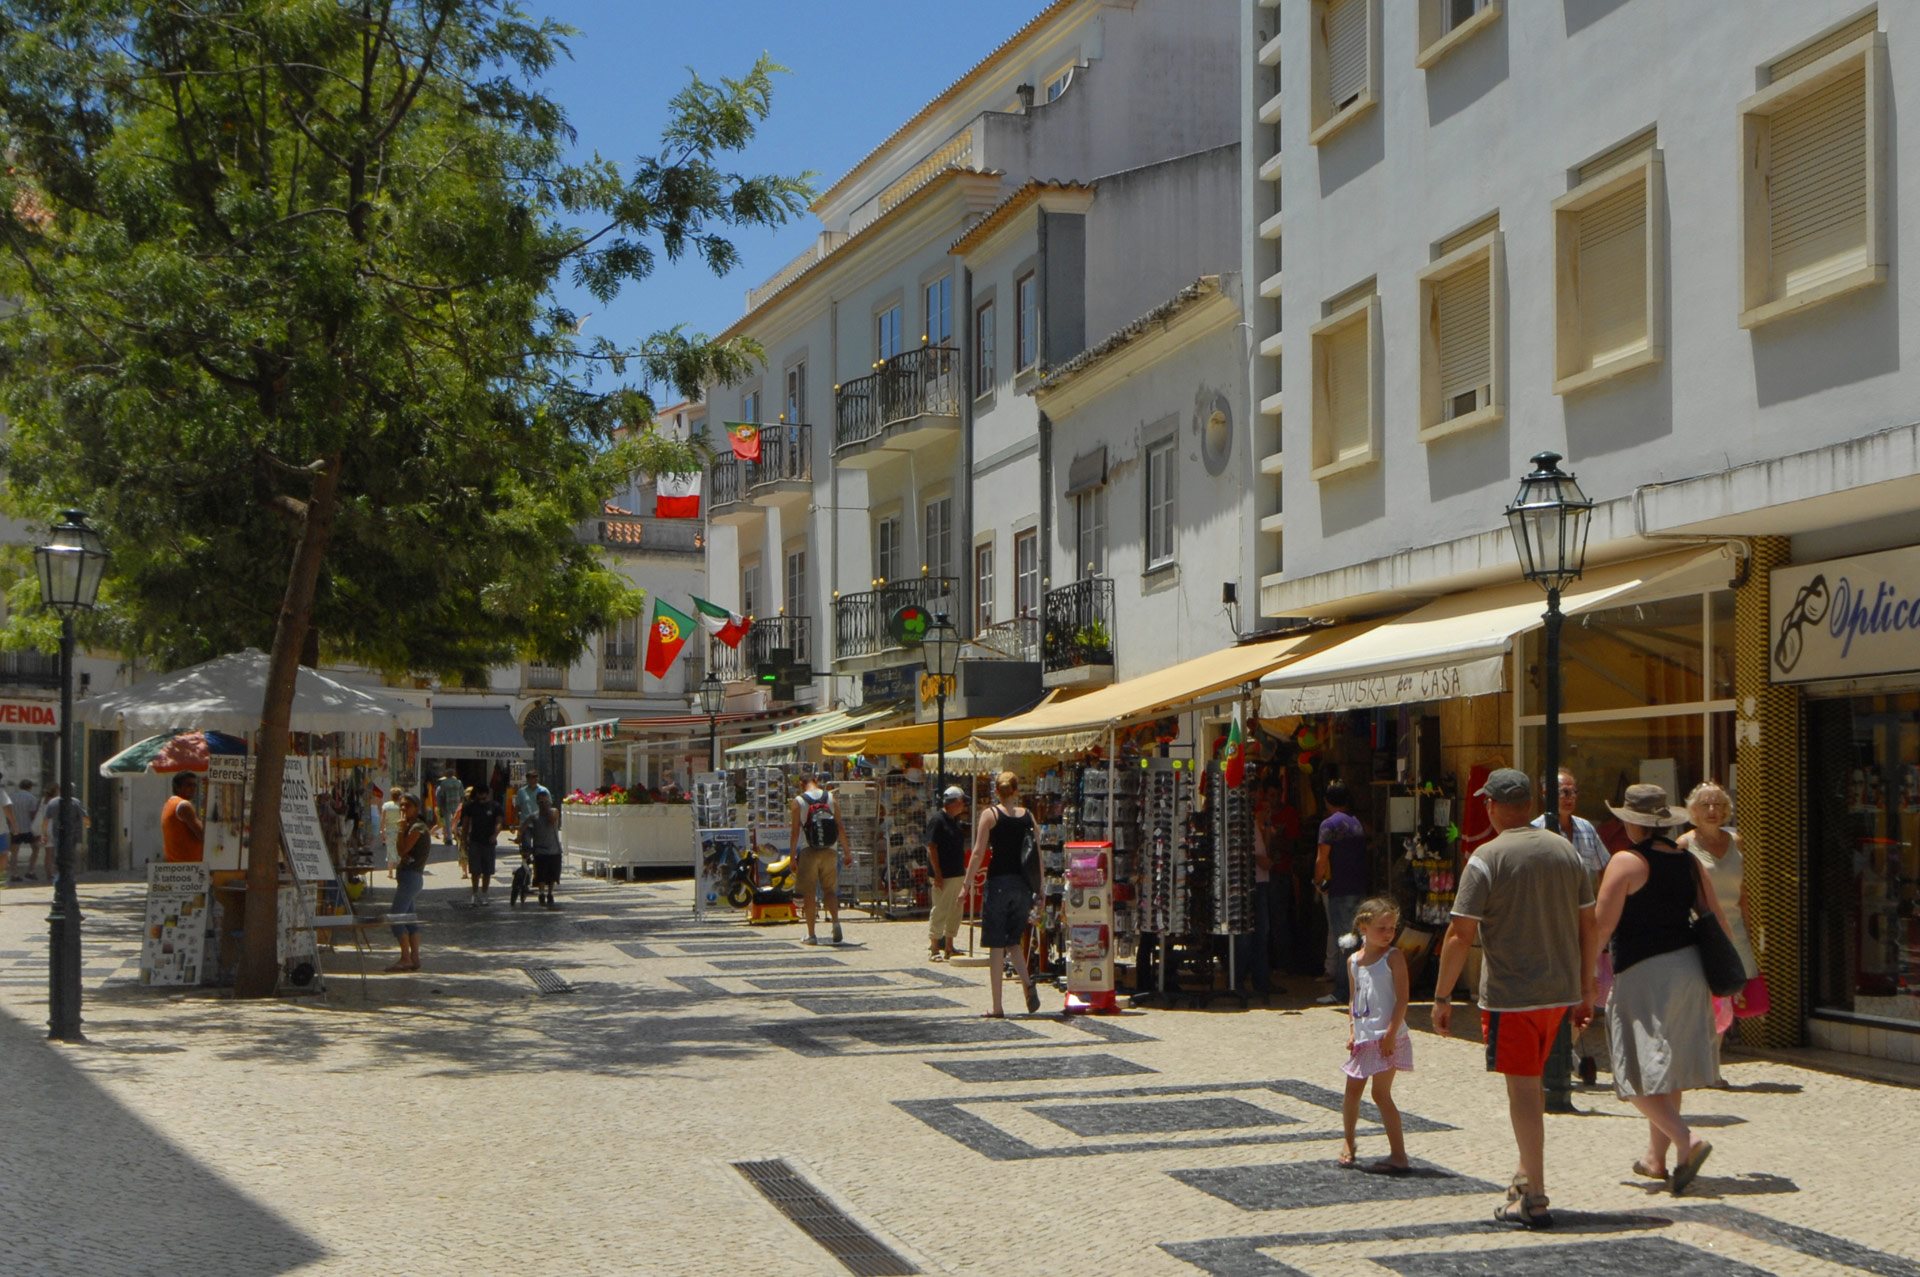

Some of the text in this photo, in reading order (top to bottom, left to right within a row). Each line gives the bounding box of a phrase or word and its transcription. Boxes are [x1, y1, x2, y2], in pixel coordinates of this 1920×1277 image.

[1420, 667, 1460, 697] CASA
[283, 774, 308, 800] attoos
[154, 865, 200, 874] temporary
[161, 875, 192, 883] tattoos
[181, 883, 203, 891] color
